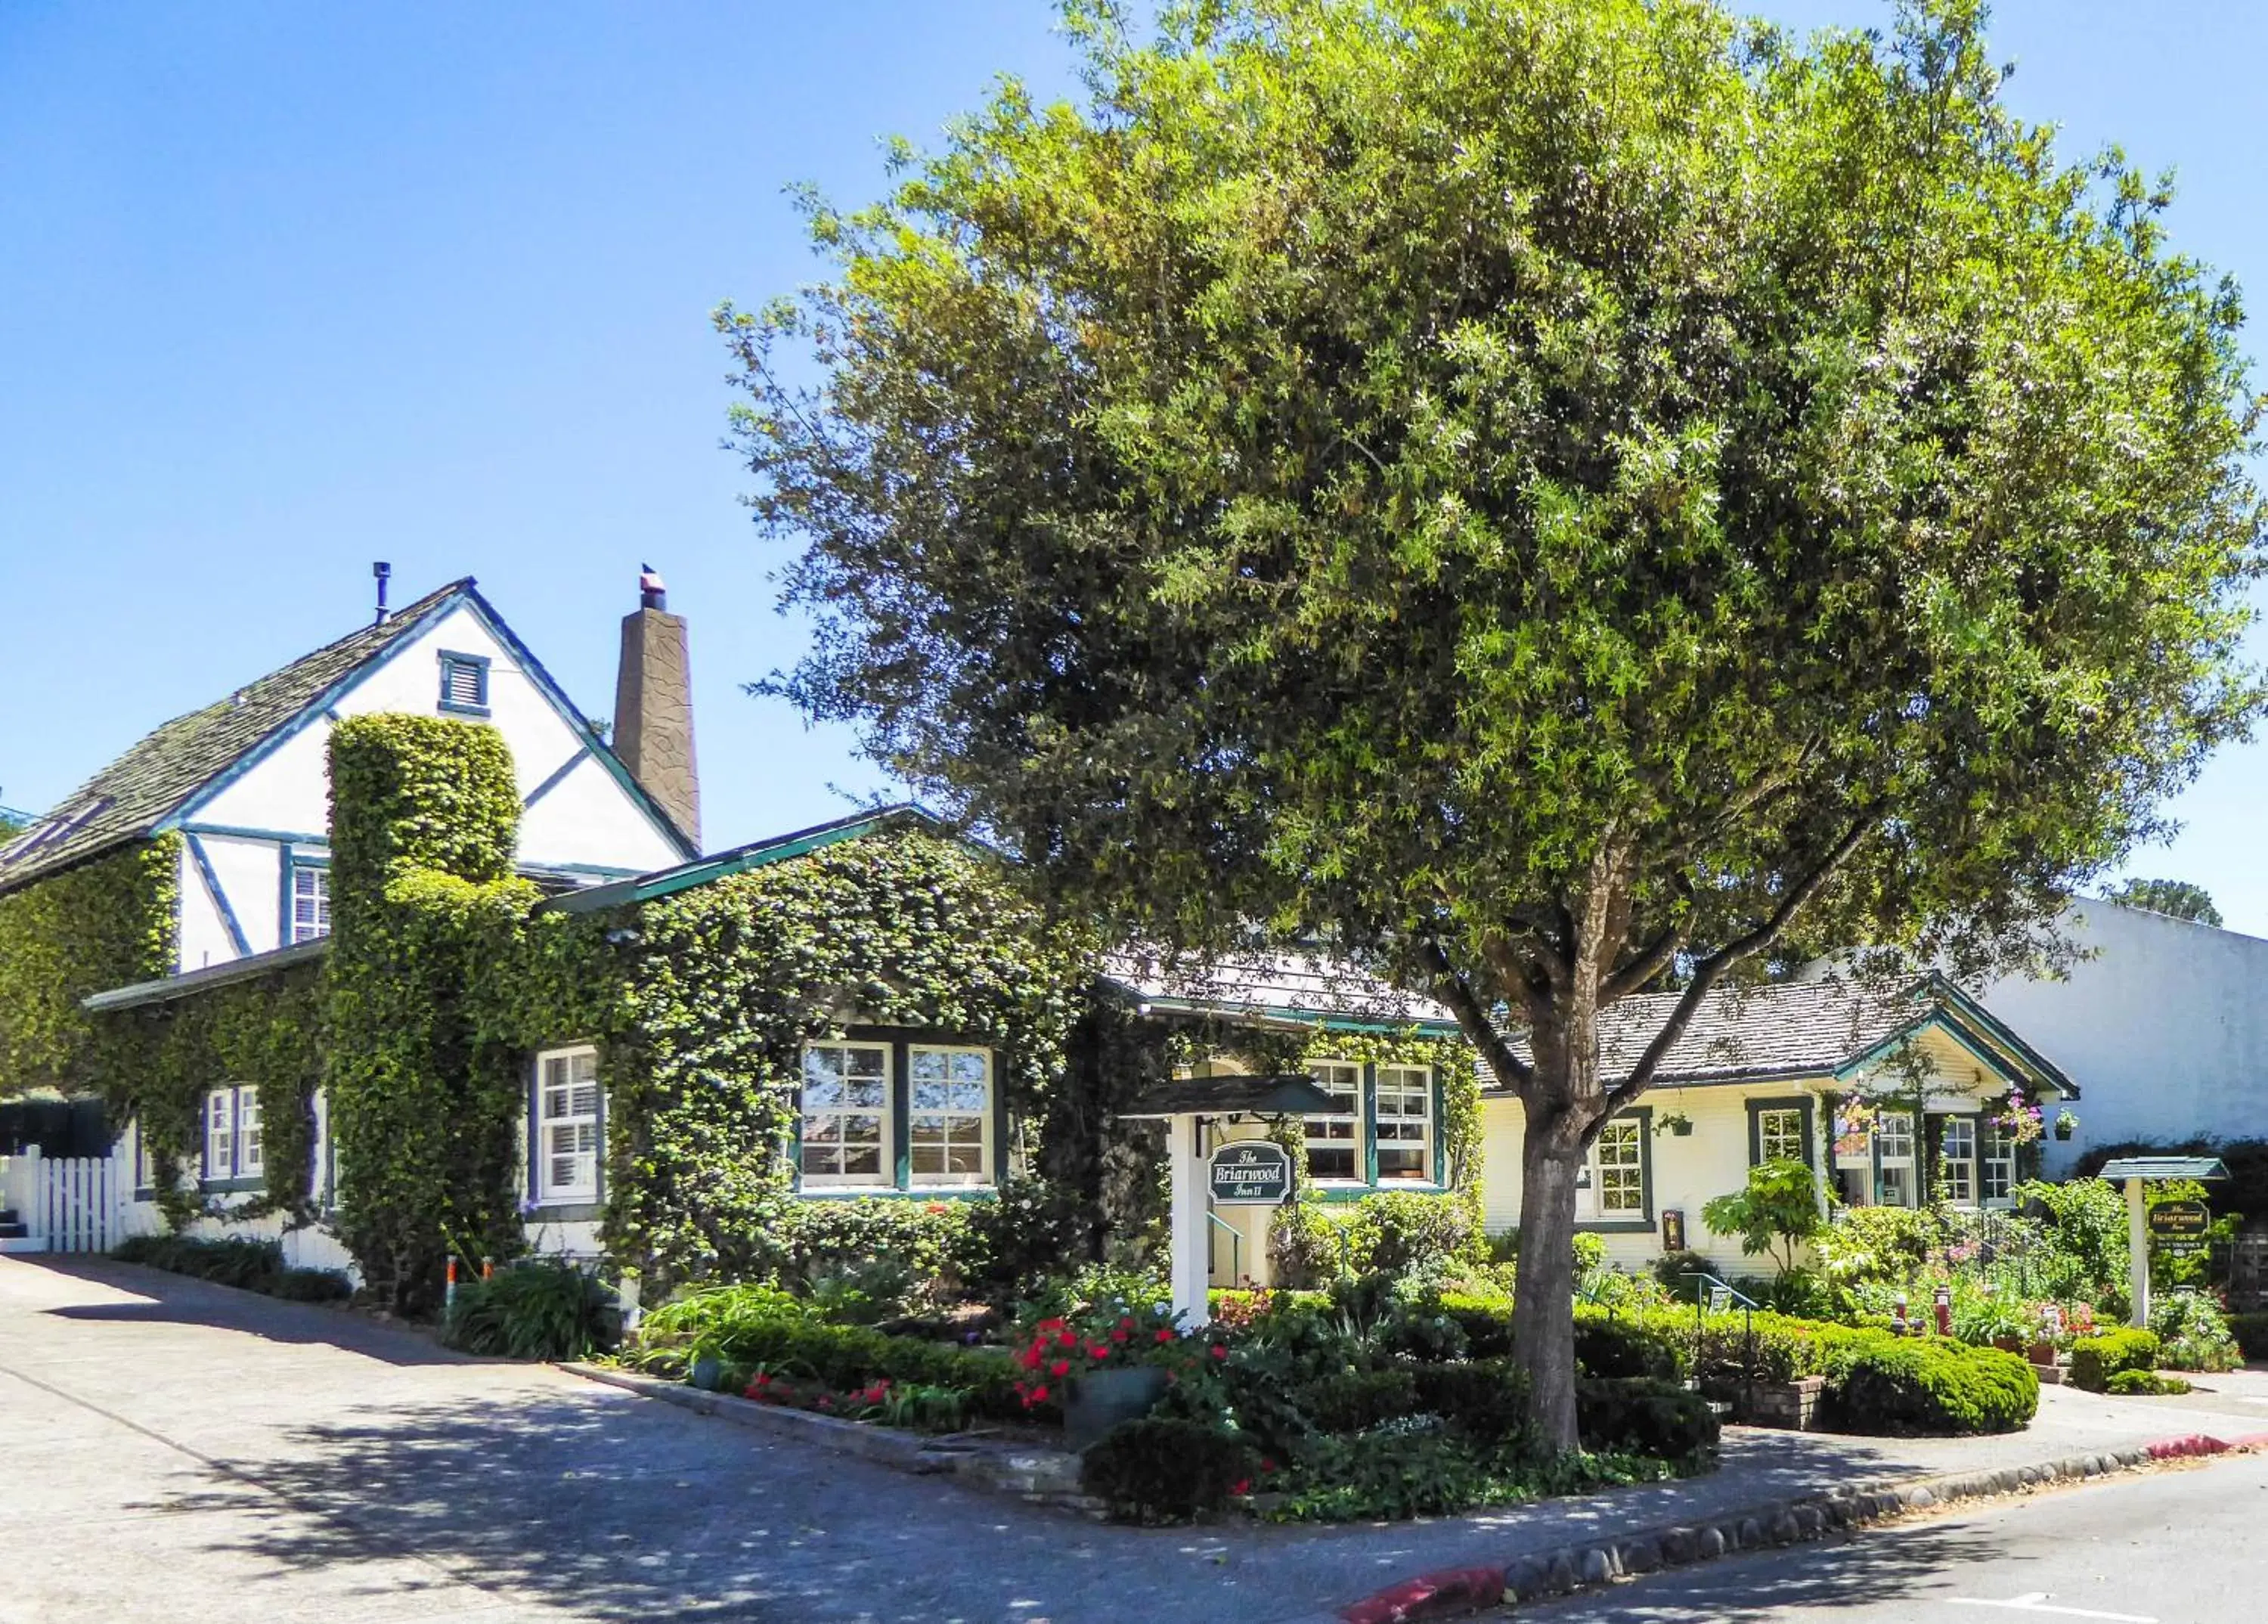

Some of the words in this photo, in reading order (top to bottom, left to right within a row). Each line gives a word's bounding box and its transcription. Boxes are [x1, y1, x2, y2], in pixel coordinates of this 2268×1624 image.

[1239, 1150, 1257, 1164] The
[1215, 1166, 1281, 1181] Briarwood
[1233, 1182, 1253, 1197] Inn
